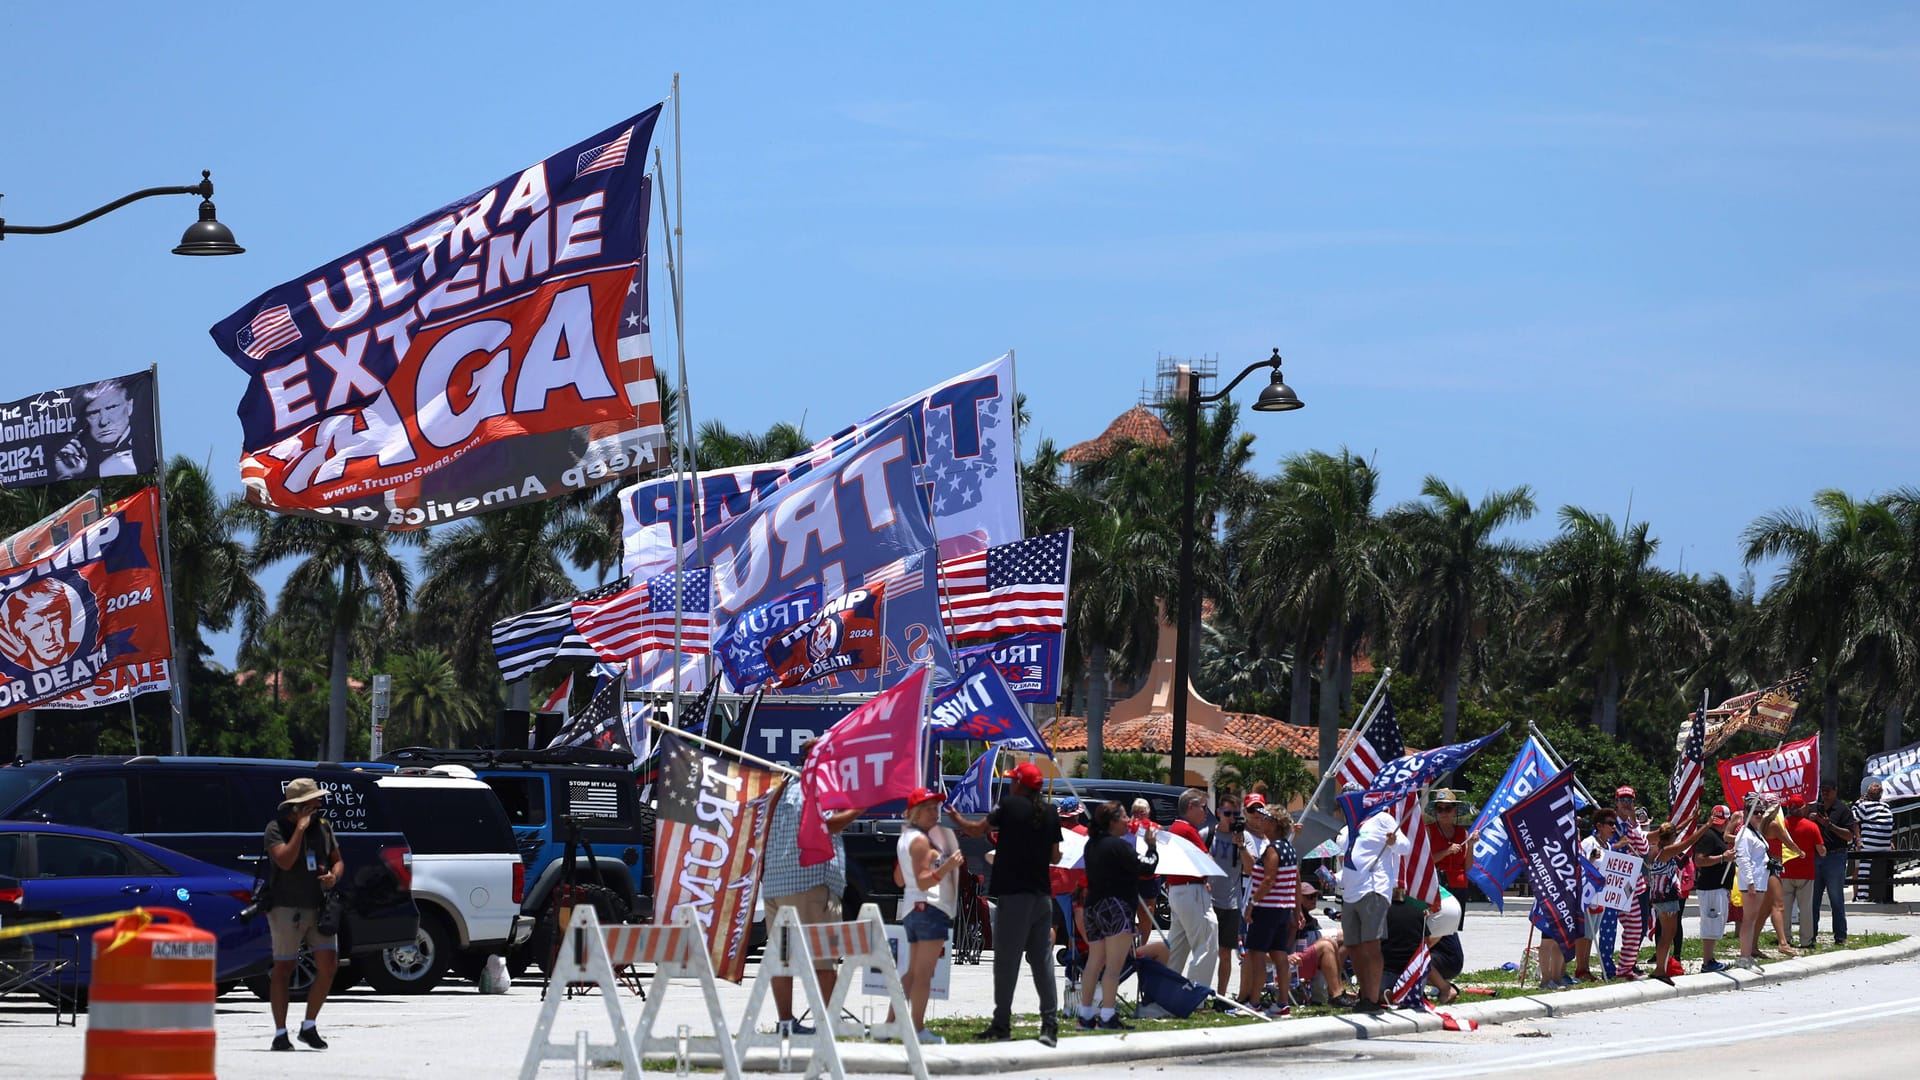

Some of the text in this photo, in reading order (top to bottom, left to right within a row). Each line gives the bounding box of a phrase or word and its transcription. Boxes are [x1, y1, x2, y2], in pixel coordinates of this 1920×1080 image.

[305, 161, 551, 331] ULTRA
[262, 191, 605, 432] EXTEME
[268, 285, 618, 494] AGA
[0, 444, 45, 473] 2024
[18, 467, 48, 481] America
[106, 587, 153, 614] 2024
[849, 629, 874, 639] 2024
[0, 644, 108, 707] OR DEATH
[92, 658, 167, 696] SALE
[813, 652, 852, 677] DEATH
[93, 695, 118, 706] Promo
[345, 808, 366, 818] ON
[1517, 820, 1576, 934] TAKE AMERICA BACK
[1606, 856, 1634, 875] NEVER
[1606, 873, 1625, 889] GIVE
[152, 943, 188, 956] ACME
